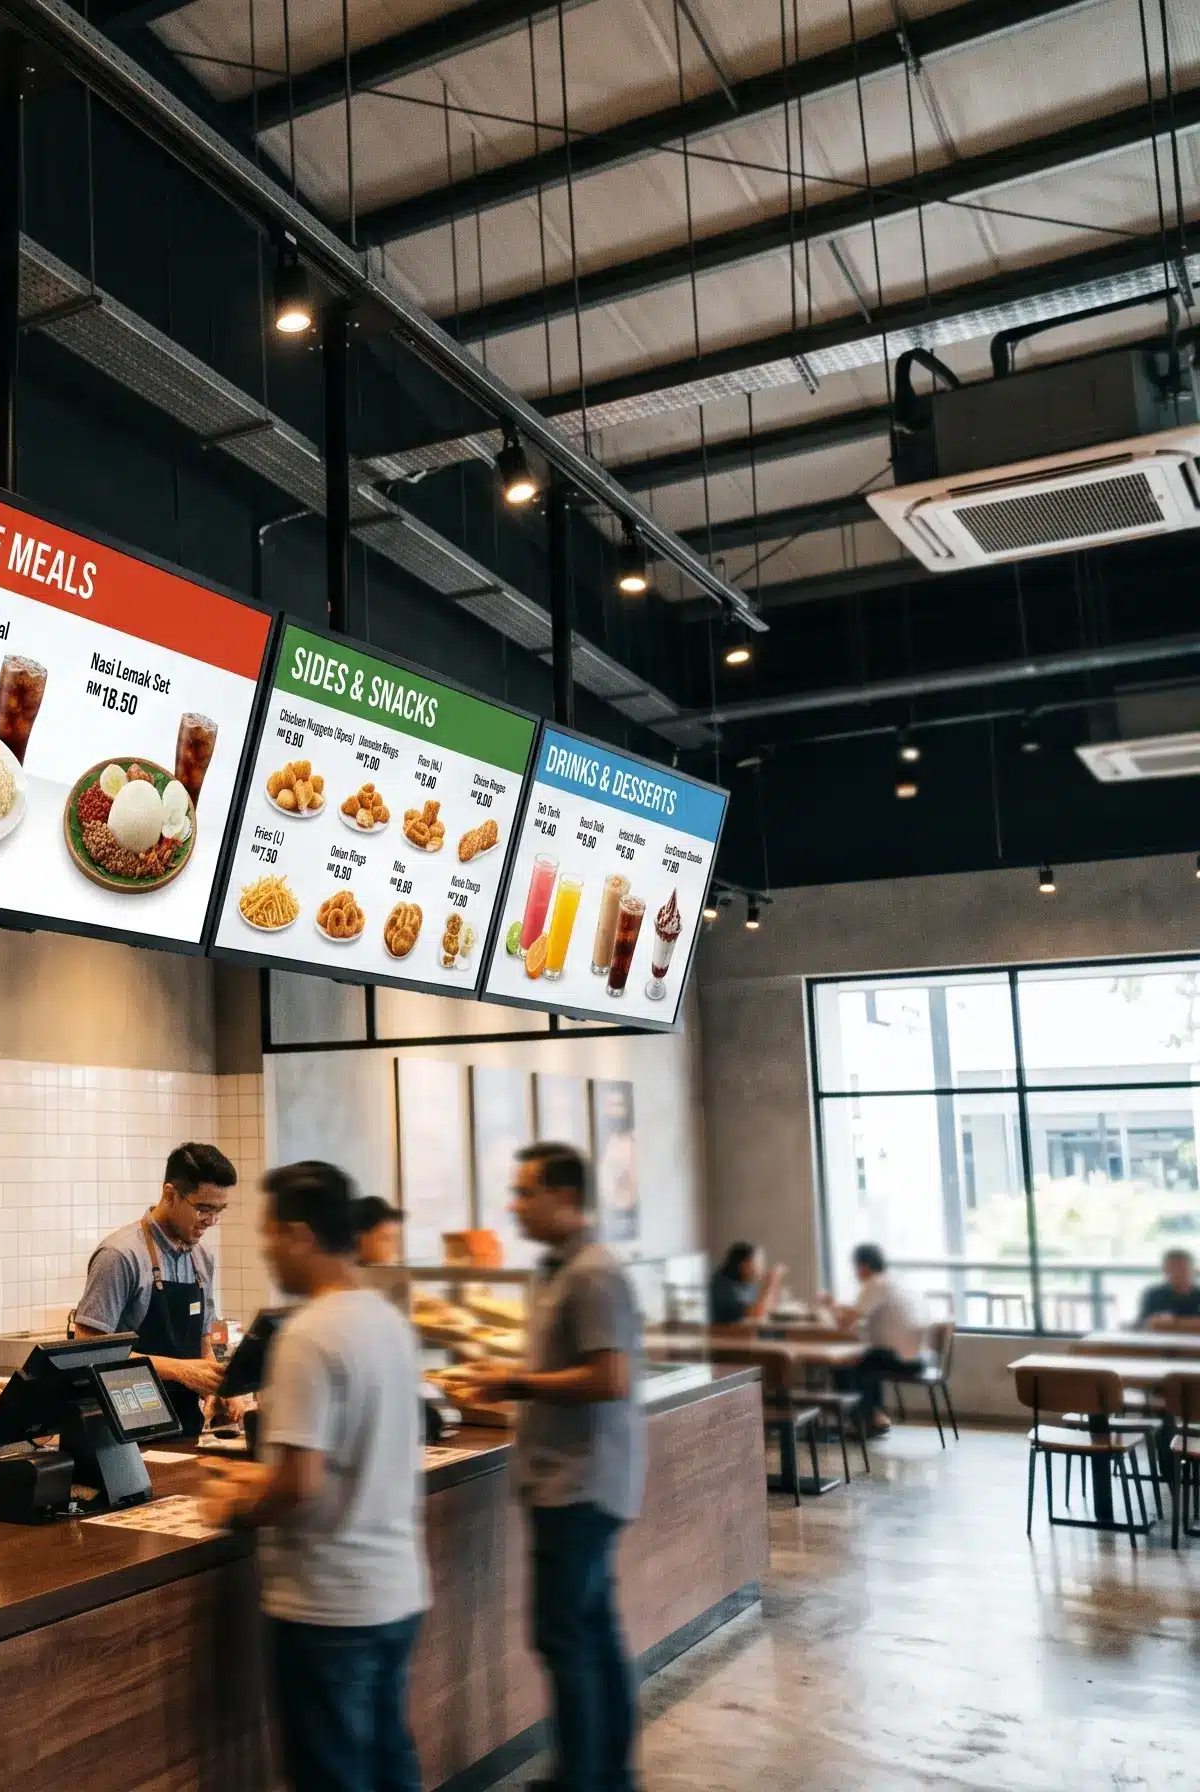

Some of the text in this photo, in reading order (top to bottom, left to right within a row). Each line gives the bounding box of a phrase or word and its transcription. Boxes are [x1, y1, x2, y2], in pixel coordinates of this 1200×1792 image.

[7, 532, 97, 599] MEALS
[86, 680, 138, 716] RM 18.50
[90, 652, 171, 694] Nasi Lemak Set
[291, 647, 439, 728] SIDES & SNACKS
[545, 745, 678, 816] DRINKS & DESSERTS
[254, 825, 273, 842] Fries
